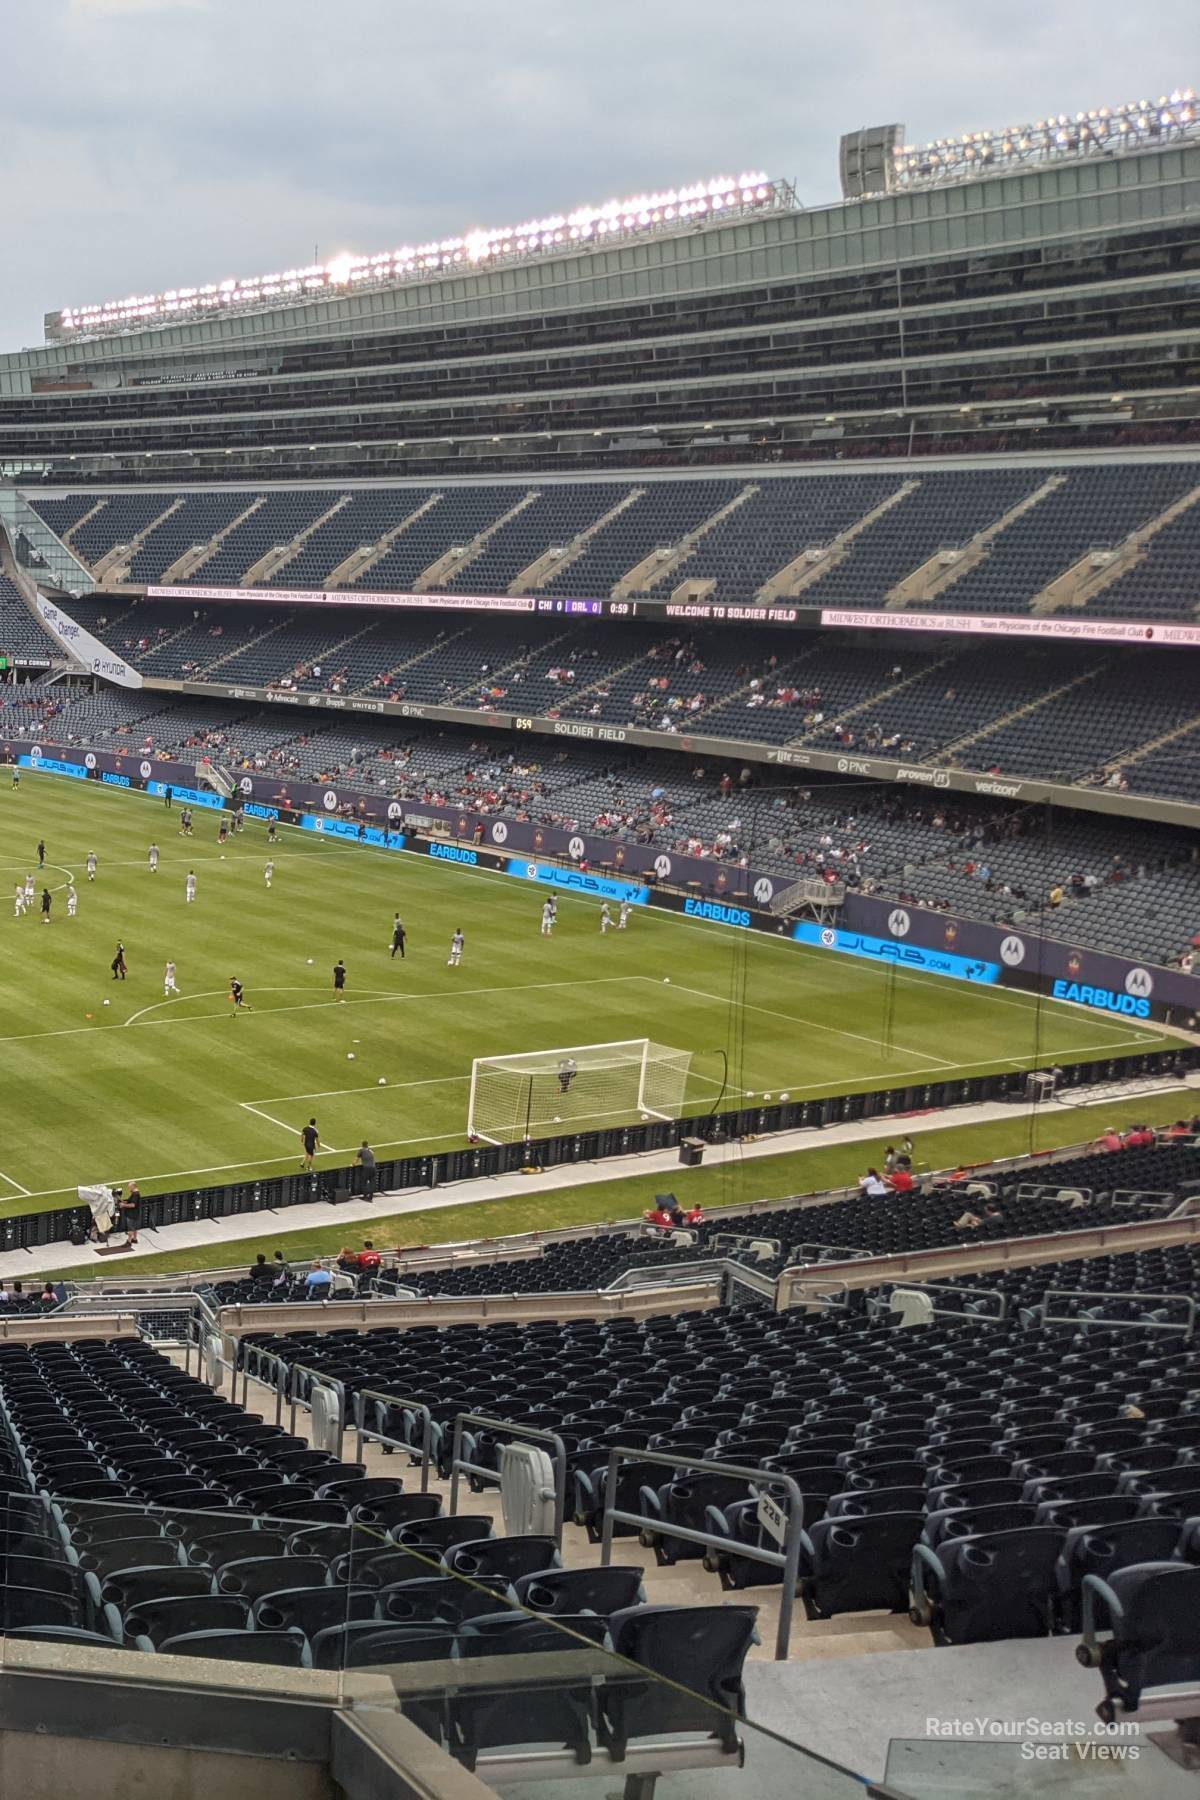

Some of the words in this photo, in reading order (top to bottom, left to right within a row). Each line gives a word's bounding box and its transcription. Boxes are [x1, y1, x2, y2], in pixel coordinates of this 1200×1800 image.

[538, 600, 552, 610] CHI
[556, 601, 562, 612] 0
[592, 602, 598, 613] 0
[610, 604, 628, 614] 0:59
[666, 605, 710, 617] WELCOME
[712, 606, 724, 618] TO
[727, 607, 766, 620] SOLDIER
[768, 609, 796, 621] FIELD
[43, 606, 58, 623] Game
[980, 620, 997, 630] Team
[999, 621, 1031, 634] Physicians
[1032, 622, 1040, 632] of
[1040, 622, 1052, 632] the
[1054, 624, 1081, 635] Chicago
[1082, 624, 1095, 634] Fire
[1097, 626, 1126, 636] Football
[1128, 627, 1144, 638] Club
[26, 659, 50, 667] CORNER
[102, 658, 126, 677] HYUNDAI
[274, 692, 298, 704] Advocate
[352, 702, 376, 710] UNITED
[409, 708, 424, 716] PNC
[516, 718, 532, 730] 0:59
[554, 722, 594, 738] SOLDIER
[598, 727, 626, 742] FIELD
[850, 762, 870, 774] PNC
[896, 768, 933, 782] proven
[102, 772, 130, 787] EARBUDS
[975, 781, 1016, 797] verizon
[244, 802, 278, 824] EARBUDS
[430, 843, 478, 865] EARBUDS
[684, 898, 750, 926] EARBUDS
[1052, 979, 1150, 1018] EARBUDS
